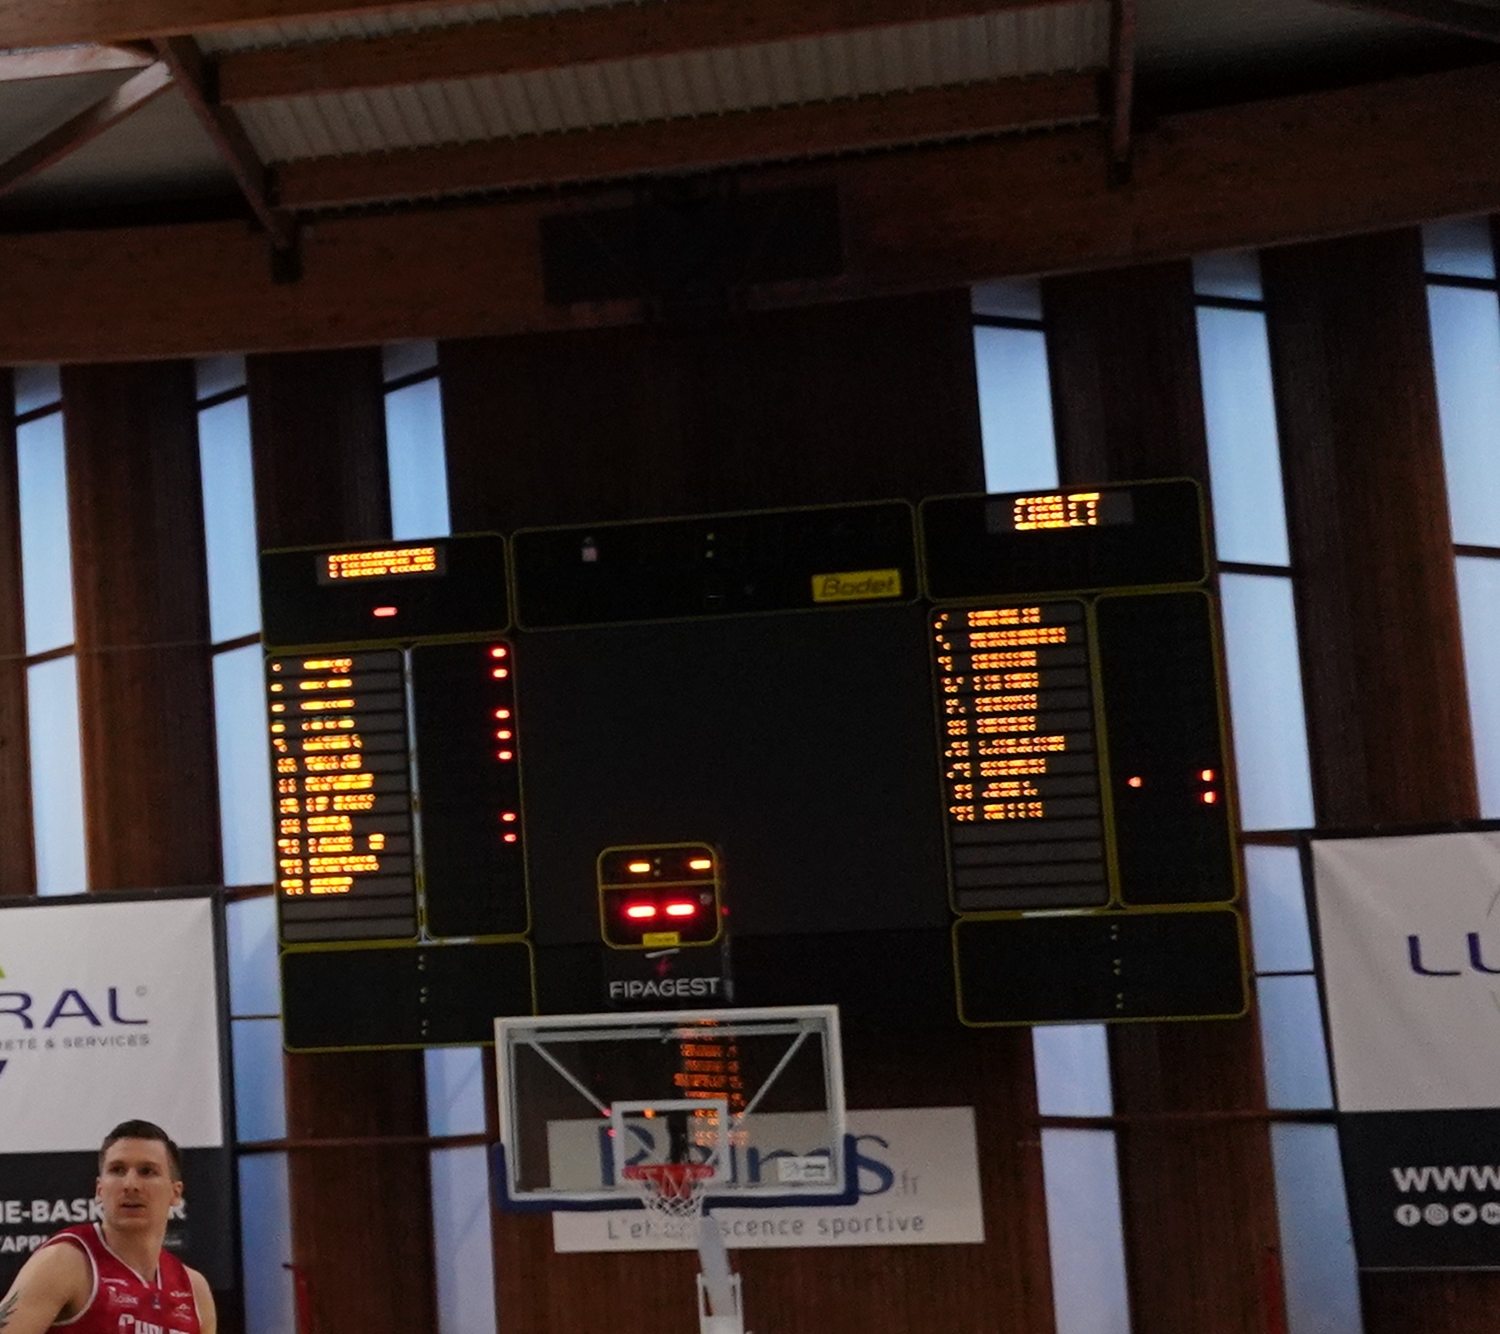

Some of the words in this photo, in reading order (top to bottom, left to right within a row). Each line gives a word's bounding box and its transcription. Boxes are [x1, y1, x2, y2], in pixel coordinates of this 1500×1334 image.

[822, 575, 894, 598] Bodet
[609, 977, 720, 999] FIPAGEST
[63, 1033, 150, 1049] SERVICES
[818, 1211, 924, 1236] sportive
